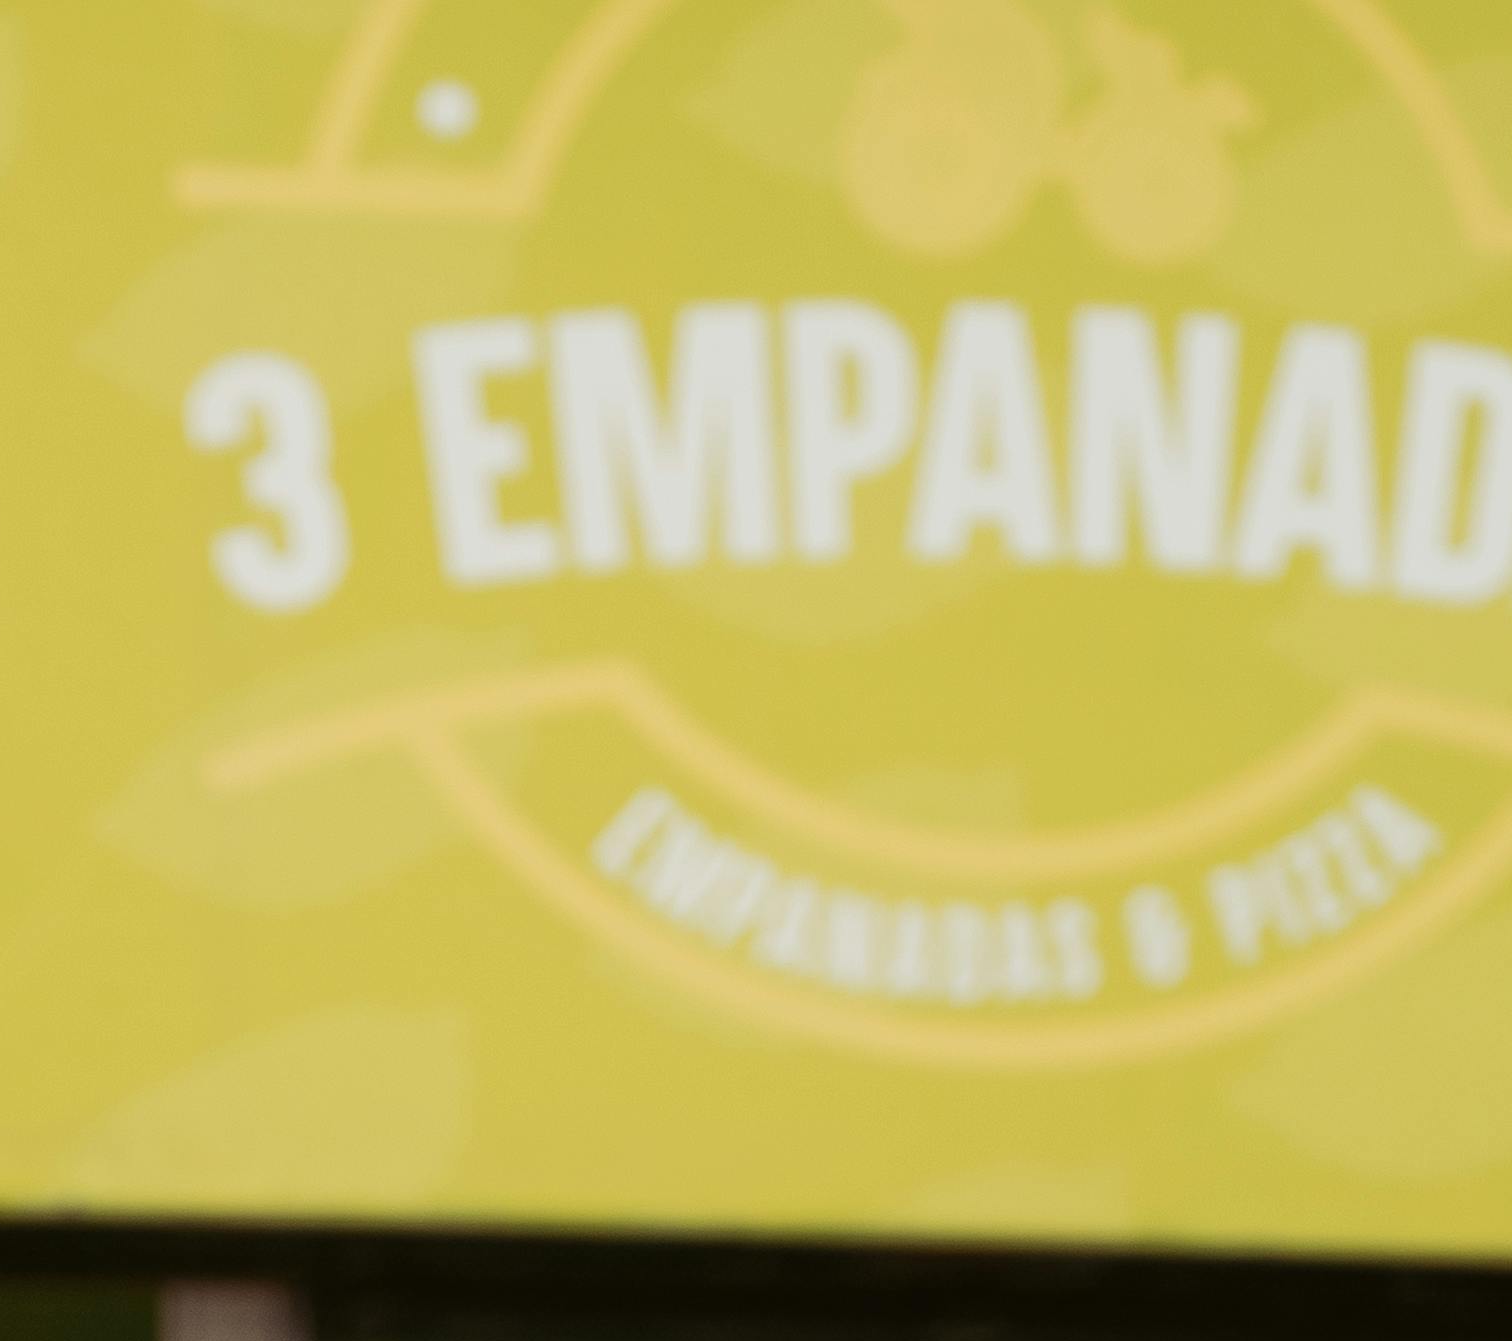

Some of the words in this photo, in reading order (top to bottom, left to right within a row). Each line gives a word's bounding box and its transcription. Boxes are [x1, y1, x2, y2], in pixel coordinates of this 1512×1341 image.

[183, 347, 353, 616] 3
[589, 786, 1104, 1007] EMPANADAS
[1207, 783, 1444, 962] PIZZA
